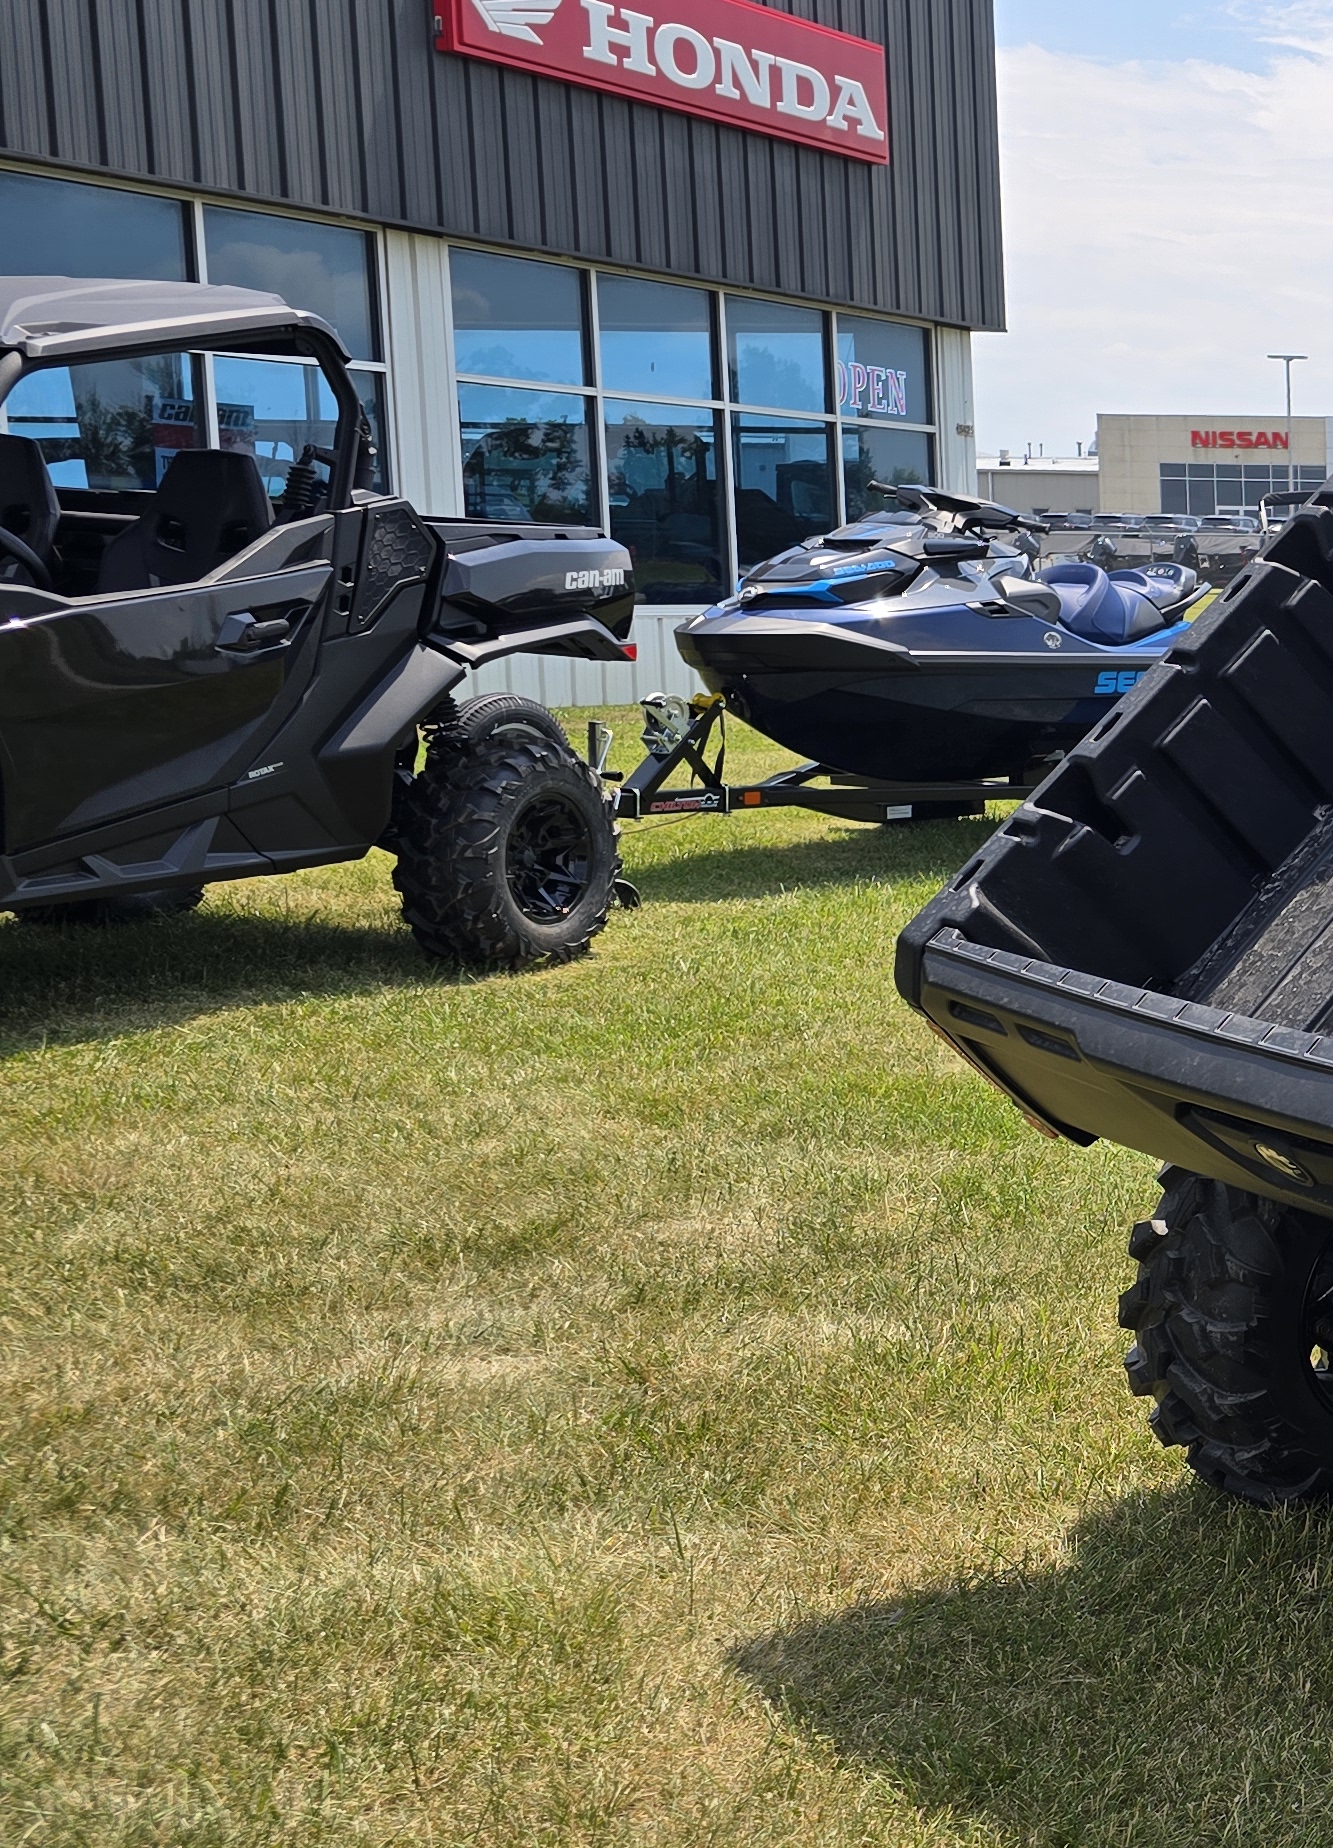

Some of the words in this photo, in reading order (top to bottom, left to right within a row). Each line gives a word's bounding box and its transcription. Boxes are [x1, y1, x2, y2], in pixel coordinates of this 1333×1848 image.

[583, 0, 884, 141] HONDA
[1190, 430, 1289, 449] NISSAN
[565, 568, 625, 590] can-am
